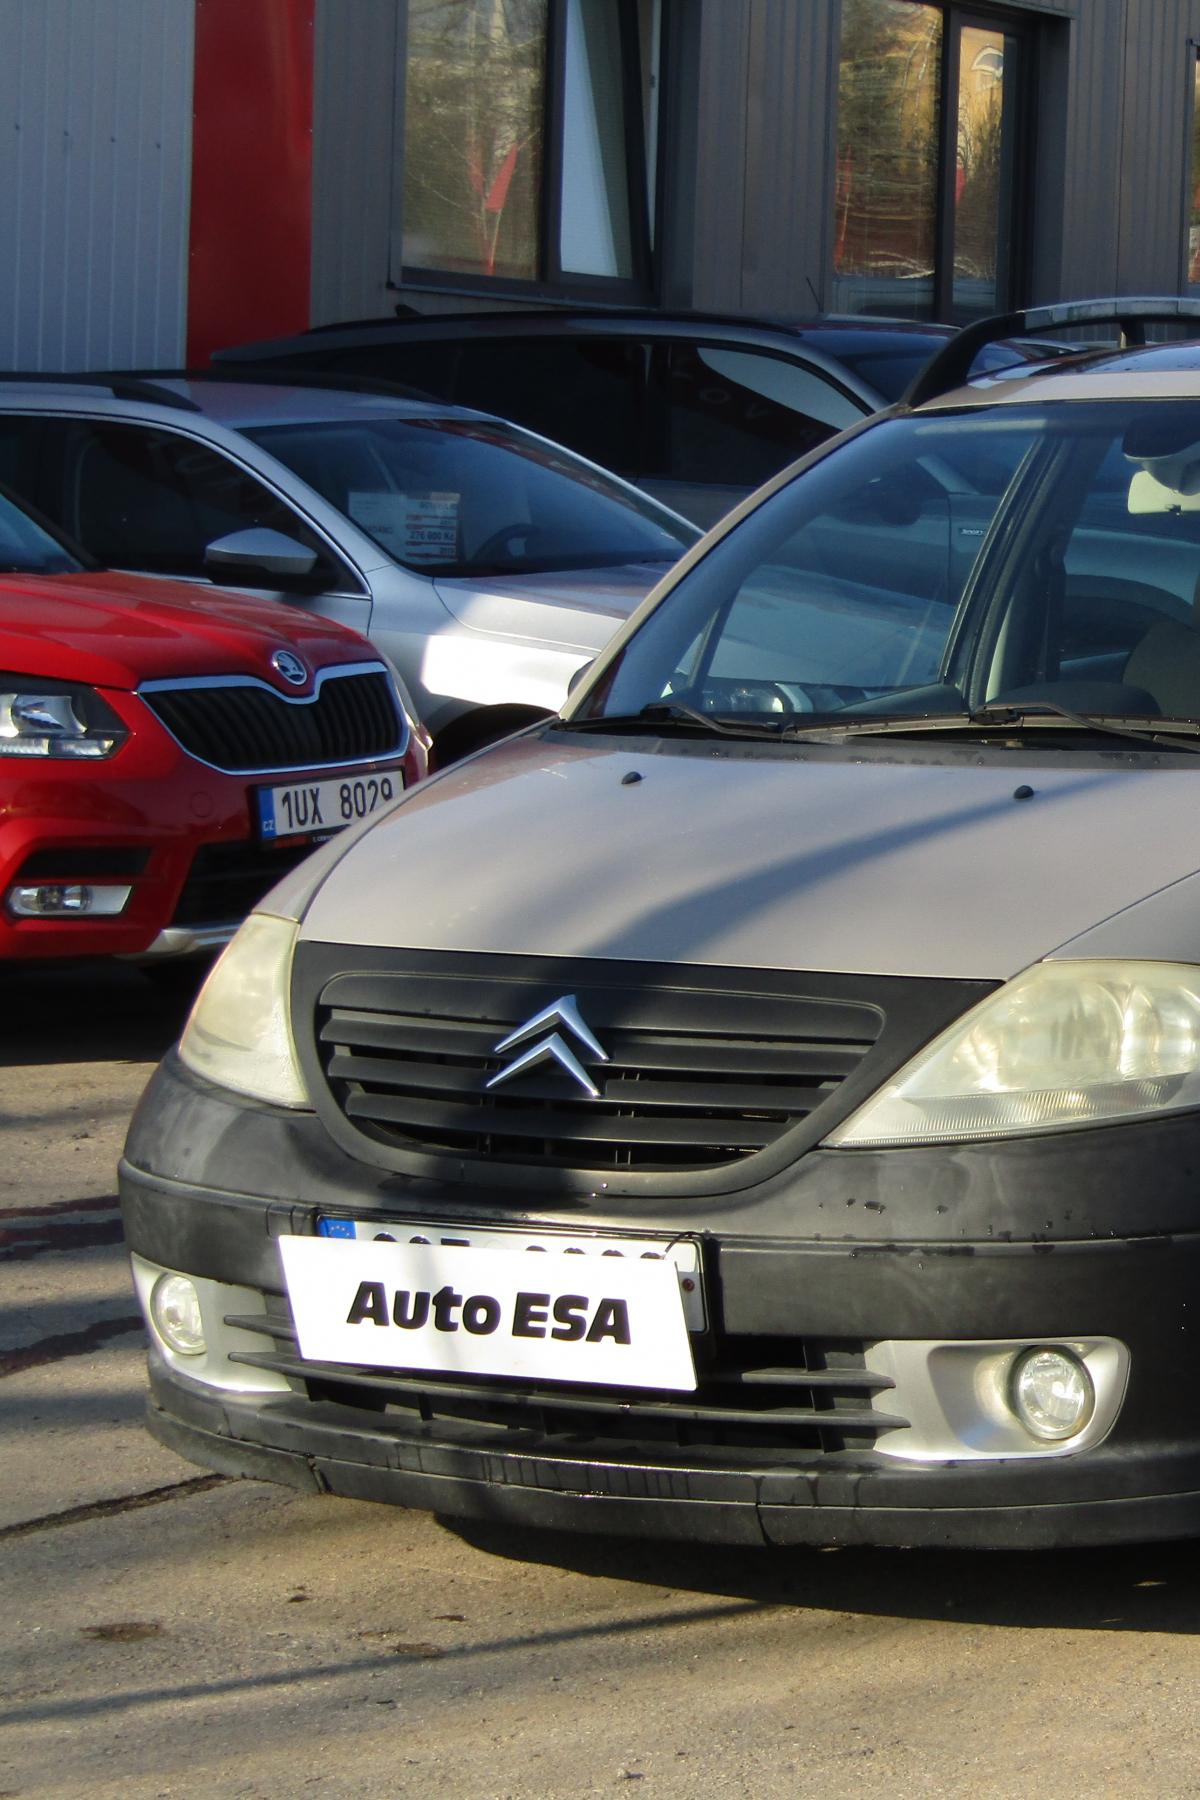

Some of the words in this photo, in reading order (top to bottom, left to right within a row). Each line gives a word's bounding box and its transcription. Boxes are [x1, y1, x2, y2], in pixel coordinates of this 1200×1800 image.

[262, 819, 275, 832] CZ
[282, 786, 323, 829] 1UX
[346, 1280, 501, 1336] Auto
[511, 1291, 631, 1345] ESA
